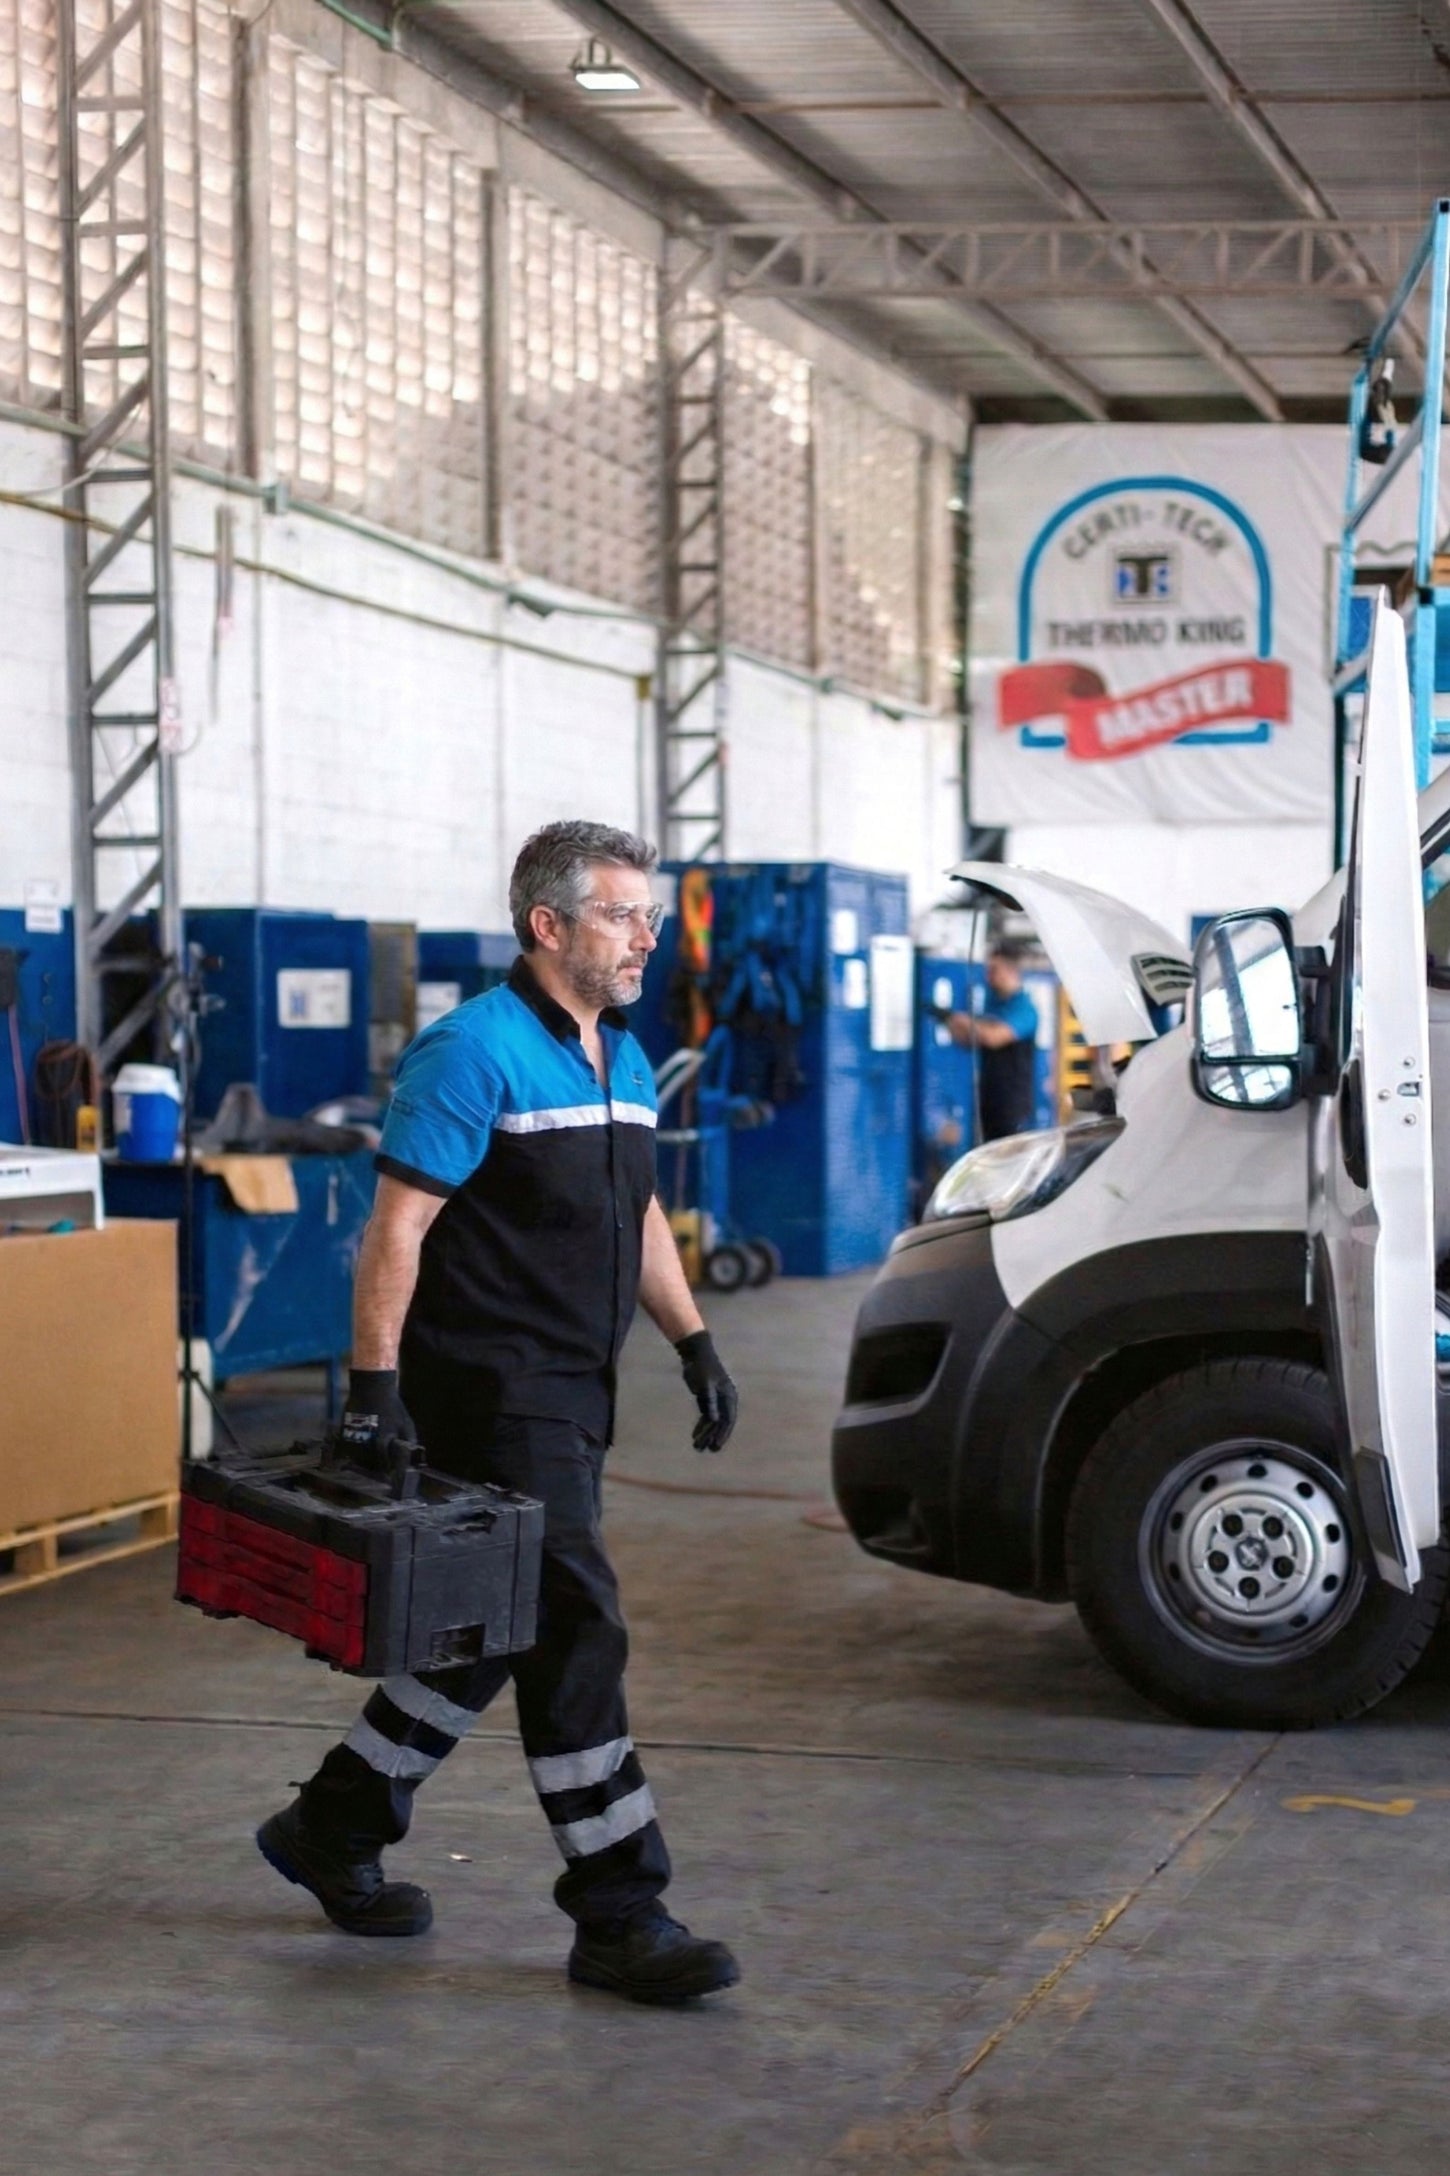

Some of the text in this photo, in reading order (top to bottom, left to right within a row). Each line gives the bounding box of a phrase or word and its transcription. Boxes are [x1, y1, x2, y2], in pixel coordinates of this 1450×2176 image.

[1047, 614, 1246, 647] THERMO KING
[1097, 667, 1253, 745] MASTER
